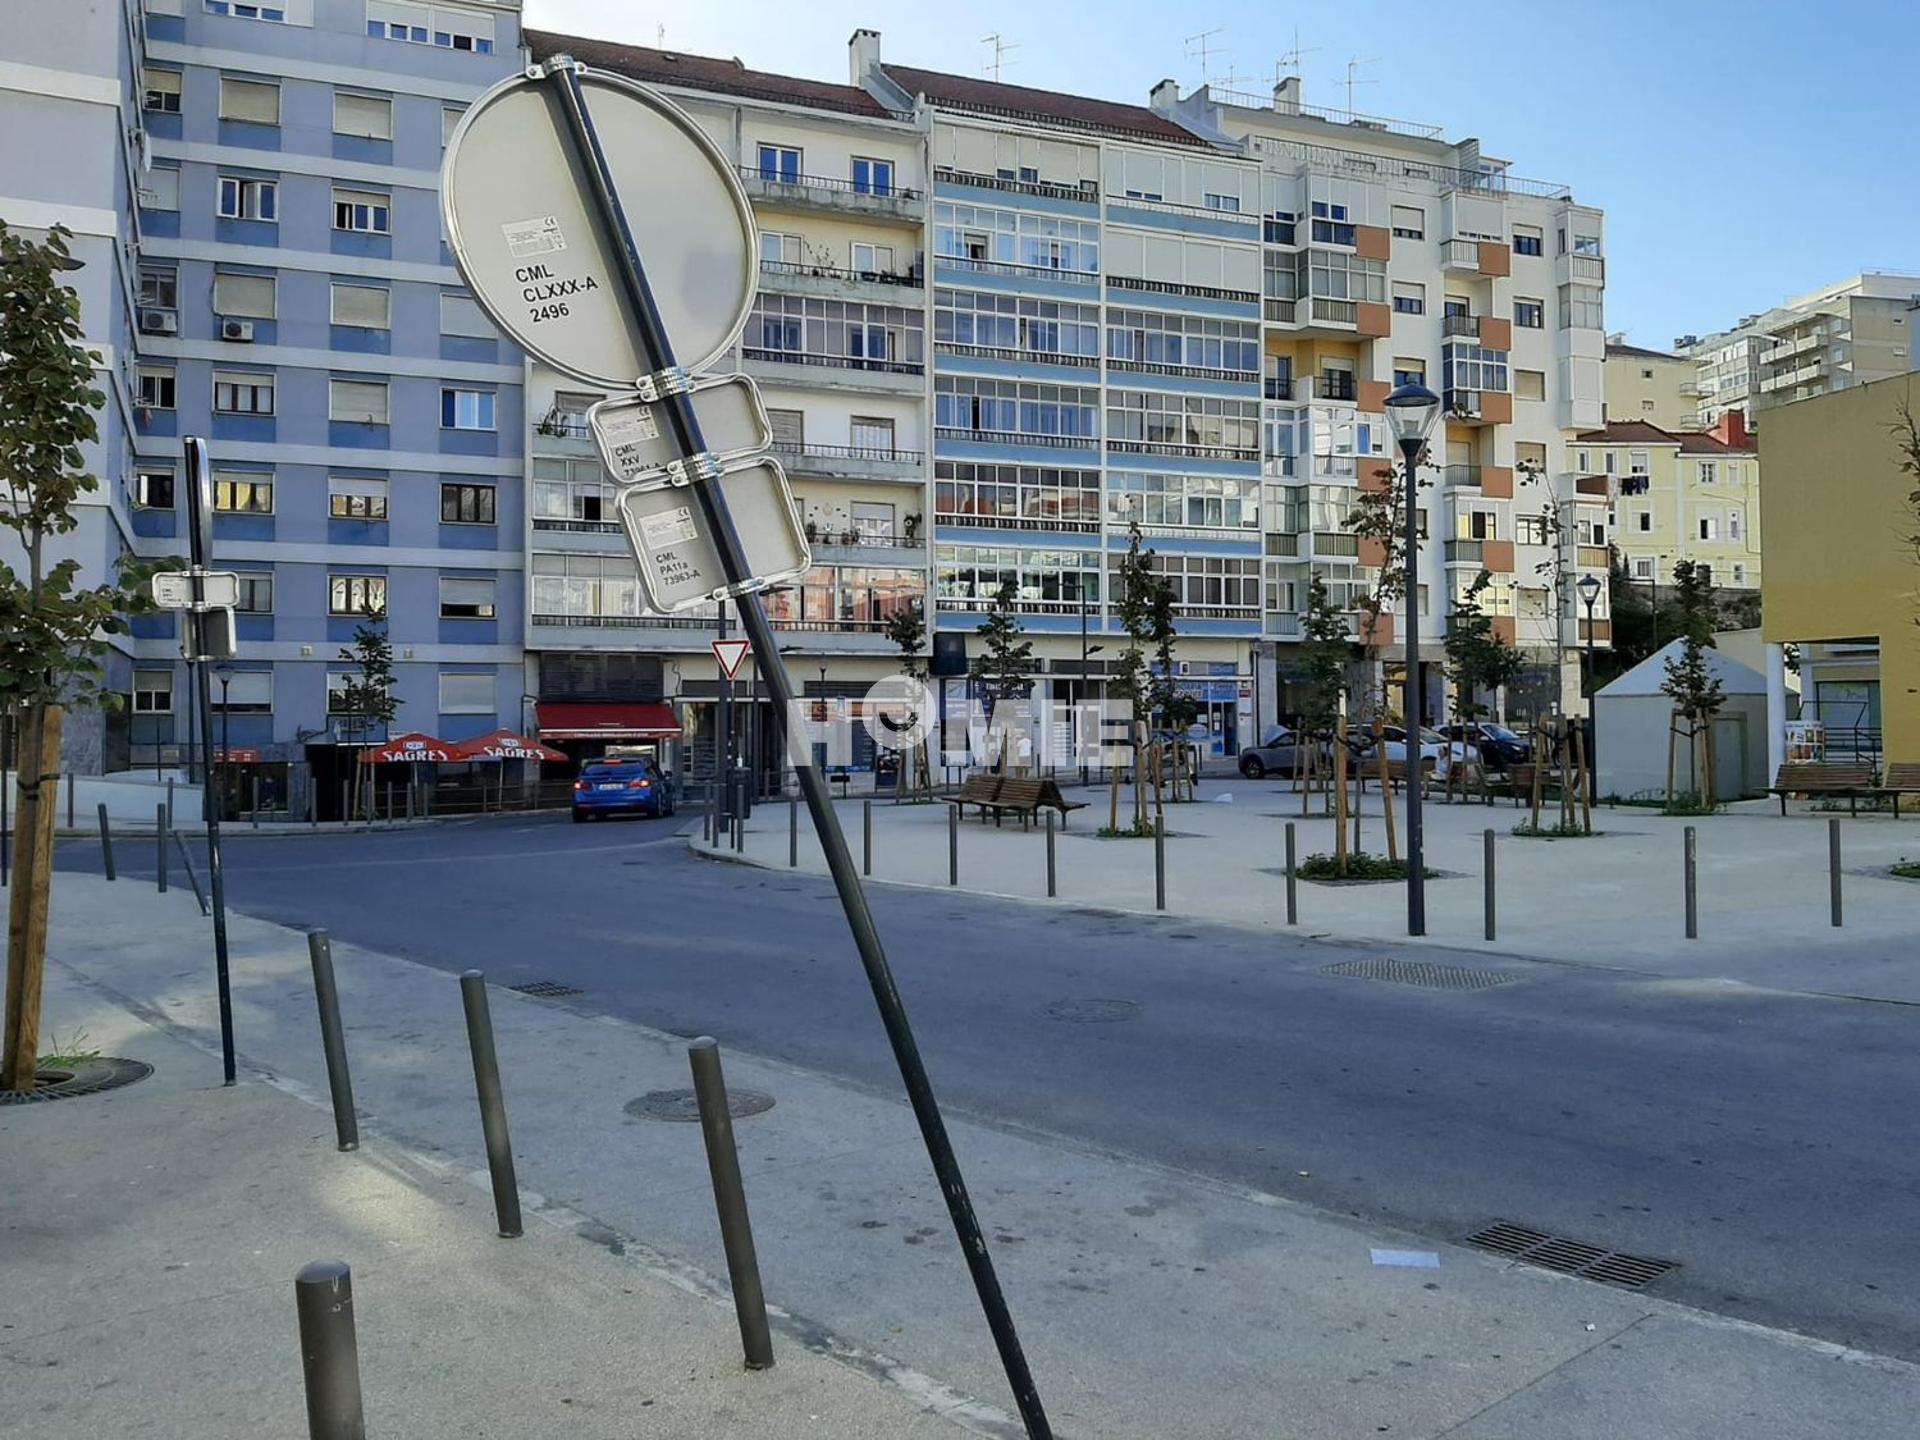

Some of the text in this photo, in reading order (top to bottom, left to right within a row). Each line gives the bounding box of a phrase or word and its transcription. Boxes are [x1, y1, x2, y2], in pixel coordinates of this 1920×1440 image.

[515, 264, 554, 283] CML
[523, 276, 599, 302] CLXXX-A
[530, 302, 570, 323] 2496
[615, 444, 636, 457] CML
[620, 455, 640, 467] XXV
[656, 551, 678, 564] CML
[382, 750, 449, 762] SAGRES
[483, 745, 545, 760] SAGRES
